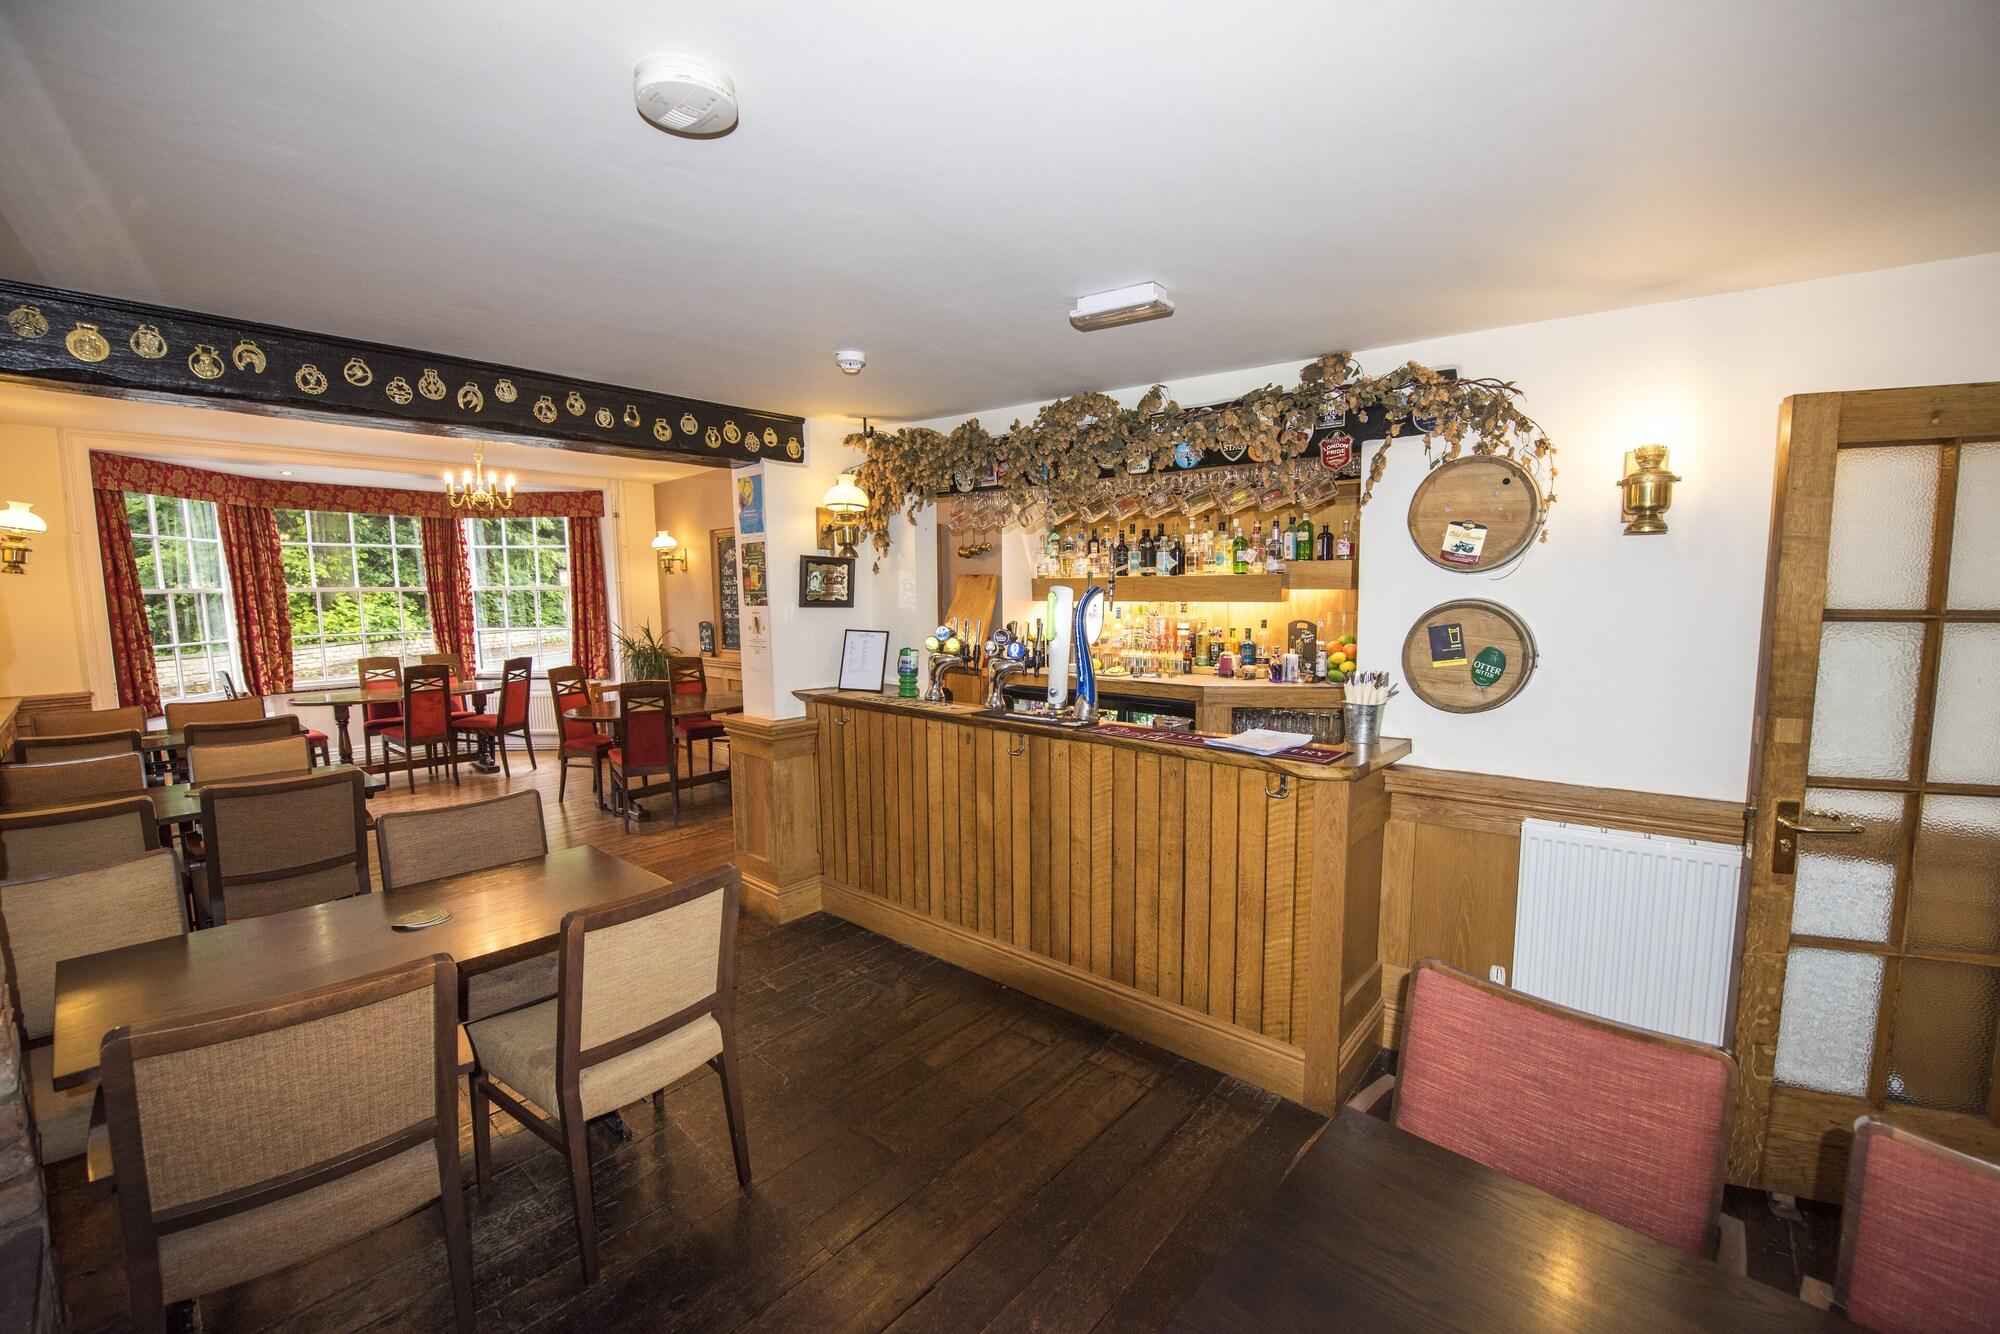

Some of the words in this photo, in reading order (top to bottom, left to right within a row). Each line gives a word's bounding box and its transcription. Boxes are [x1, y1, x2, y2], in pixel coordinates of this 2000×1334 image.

[1323, 443, 1349, 451] LONDON
[1473, 660, 1502, 675] OTTER
[1475, 668, 1495, 678] BITTER
